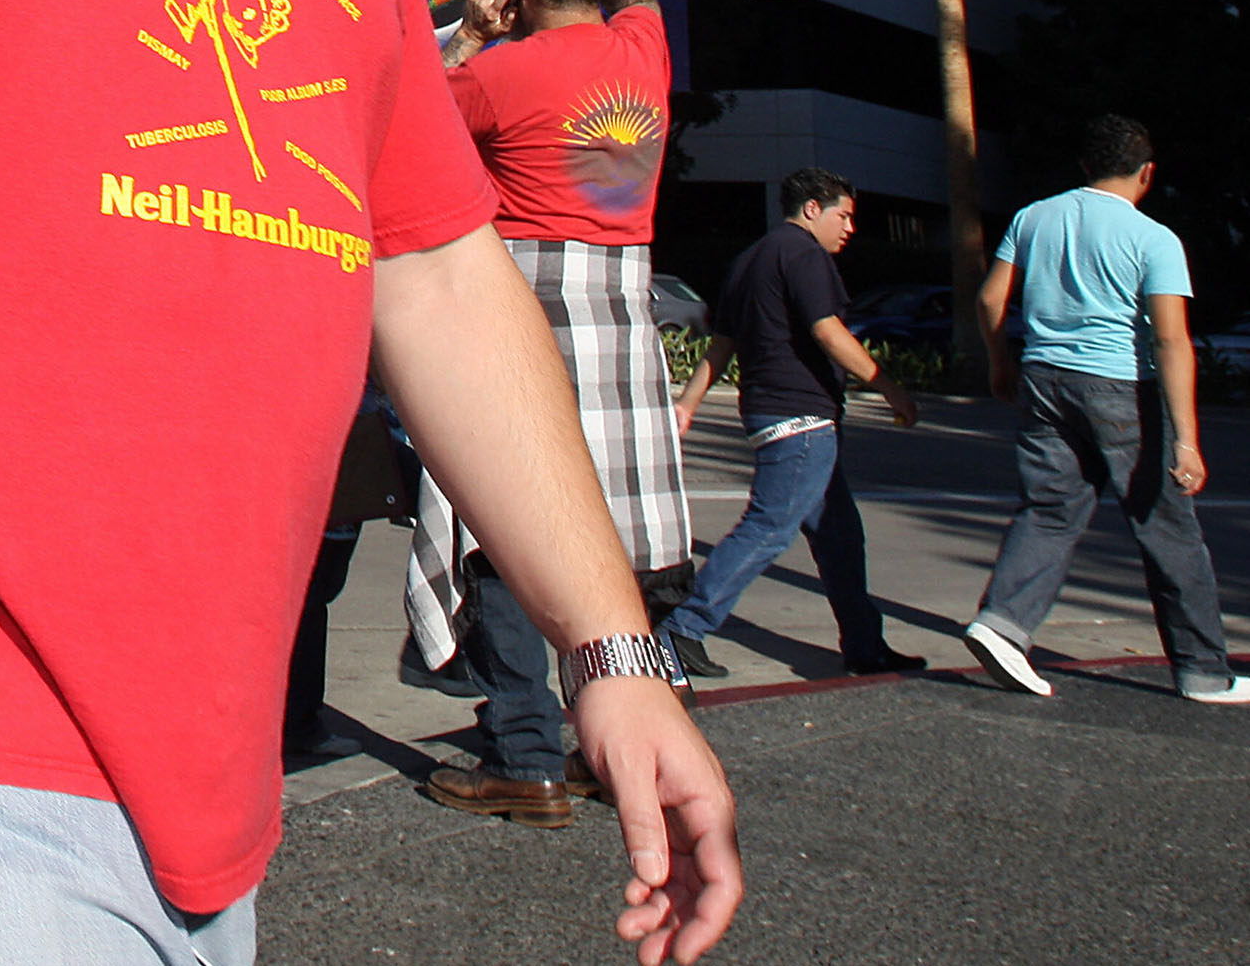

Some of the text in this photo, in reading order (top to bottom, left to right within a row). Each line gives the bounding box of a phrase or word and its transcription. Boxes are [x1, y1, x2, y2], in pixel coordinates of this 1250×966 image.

[137, 29, 191, 70] DISMAY
[125, 119, 229, 149] TUBERCULOSIS
[285, 140, 317, 170] FOOD
